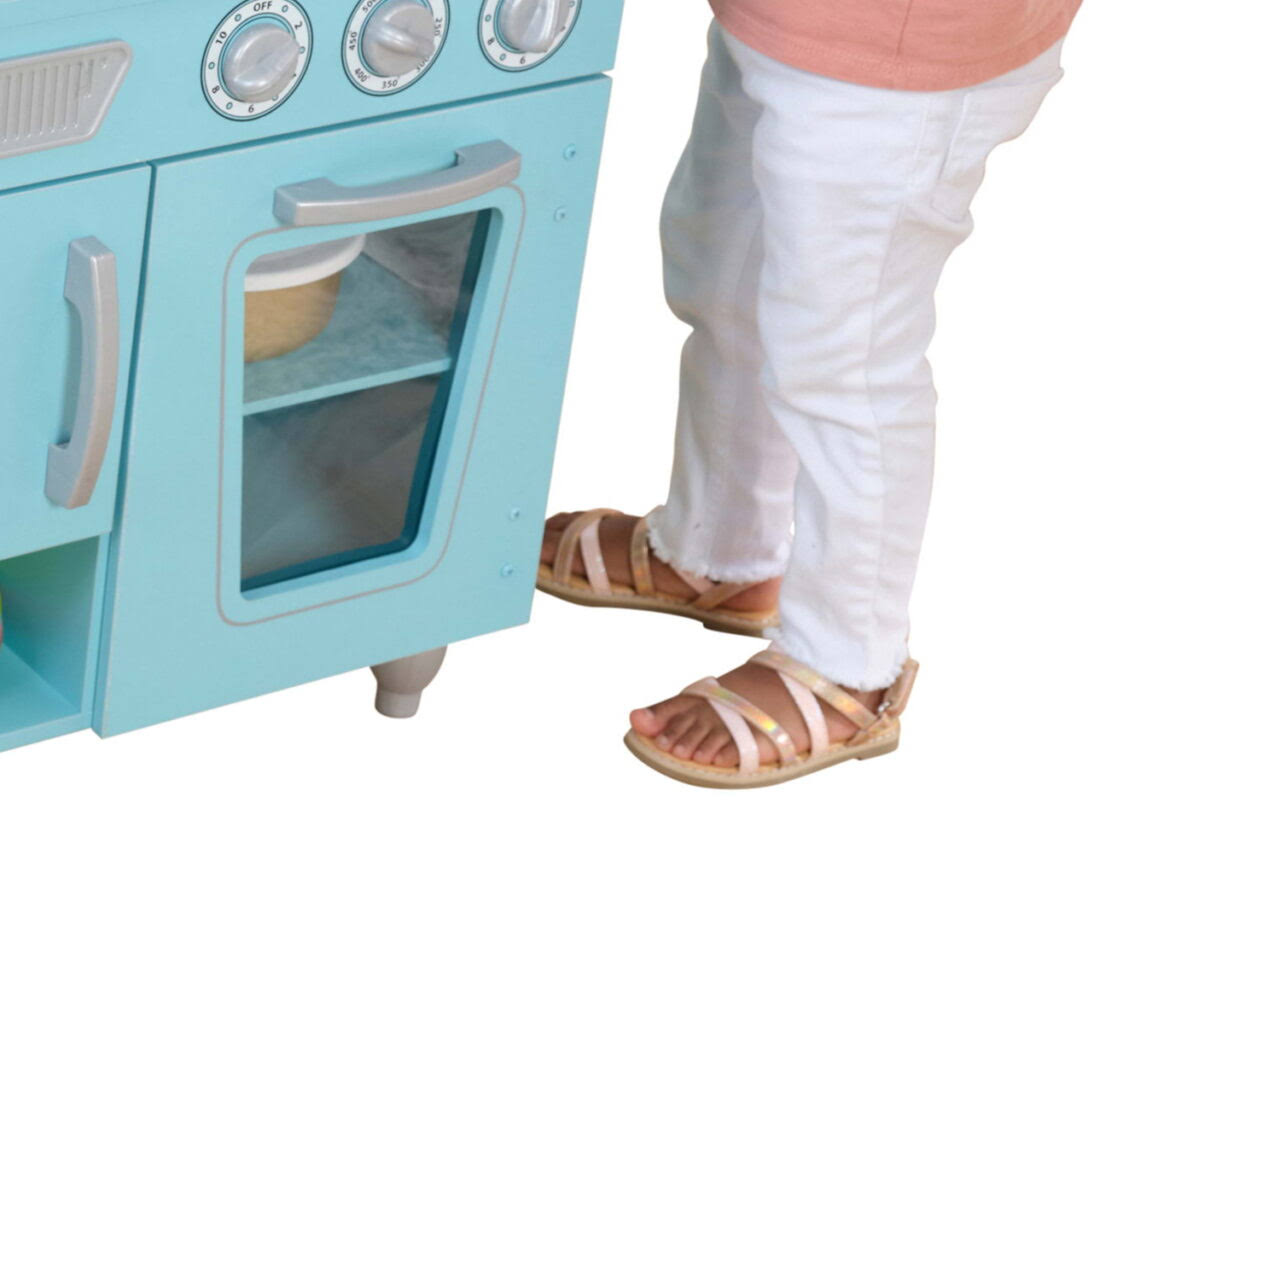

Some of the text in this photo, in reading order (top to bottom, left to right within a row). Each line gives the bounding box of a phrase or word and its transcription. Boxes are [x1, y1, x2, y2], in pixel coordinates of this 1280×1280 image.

[211, 1, 303, 113] 8 10 OFF 2 6
[520, 56, 526, 65] 6
